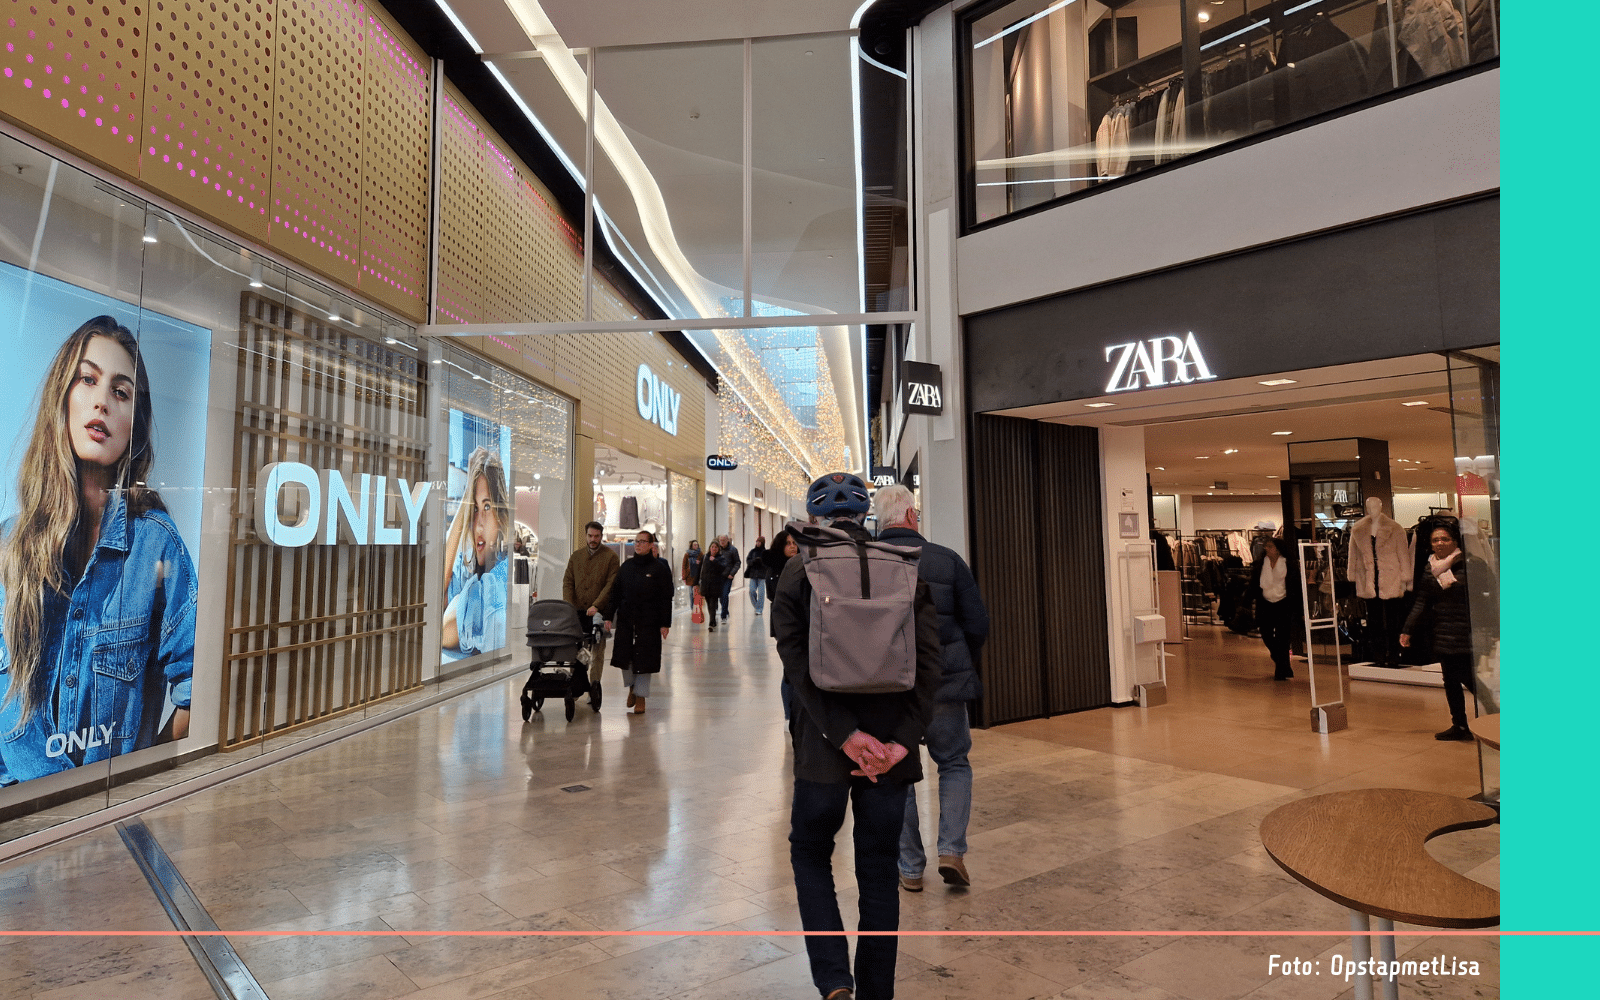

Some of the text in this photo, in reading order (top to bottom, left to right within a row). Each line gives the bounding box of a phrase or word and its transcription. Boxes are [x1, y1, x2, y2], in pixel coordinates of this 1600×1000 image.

[1105, 331, 1218, 393] ZARA
[637, 363, 681, 437] ONLY
[907, 381, 942, 408] ZARA
[708, 458, 736, 467] ONLY
[873, 475, 896, 486] ZARA
[255, 461, 432, 548] ONLY
[45, 721, 117, 758] ONLY
